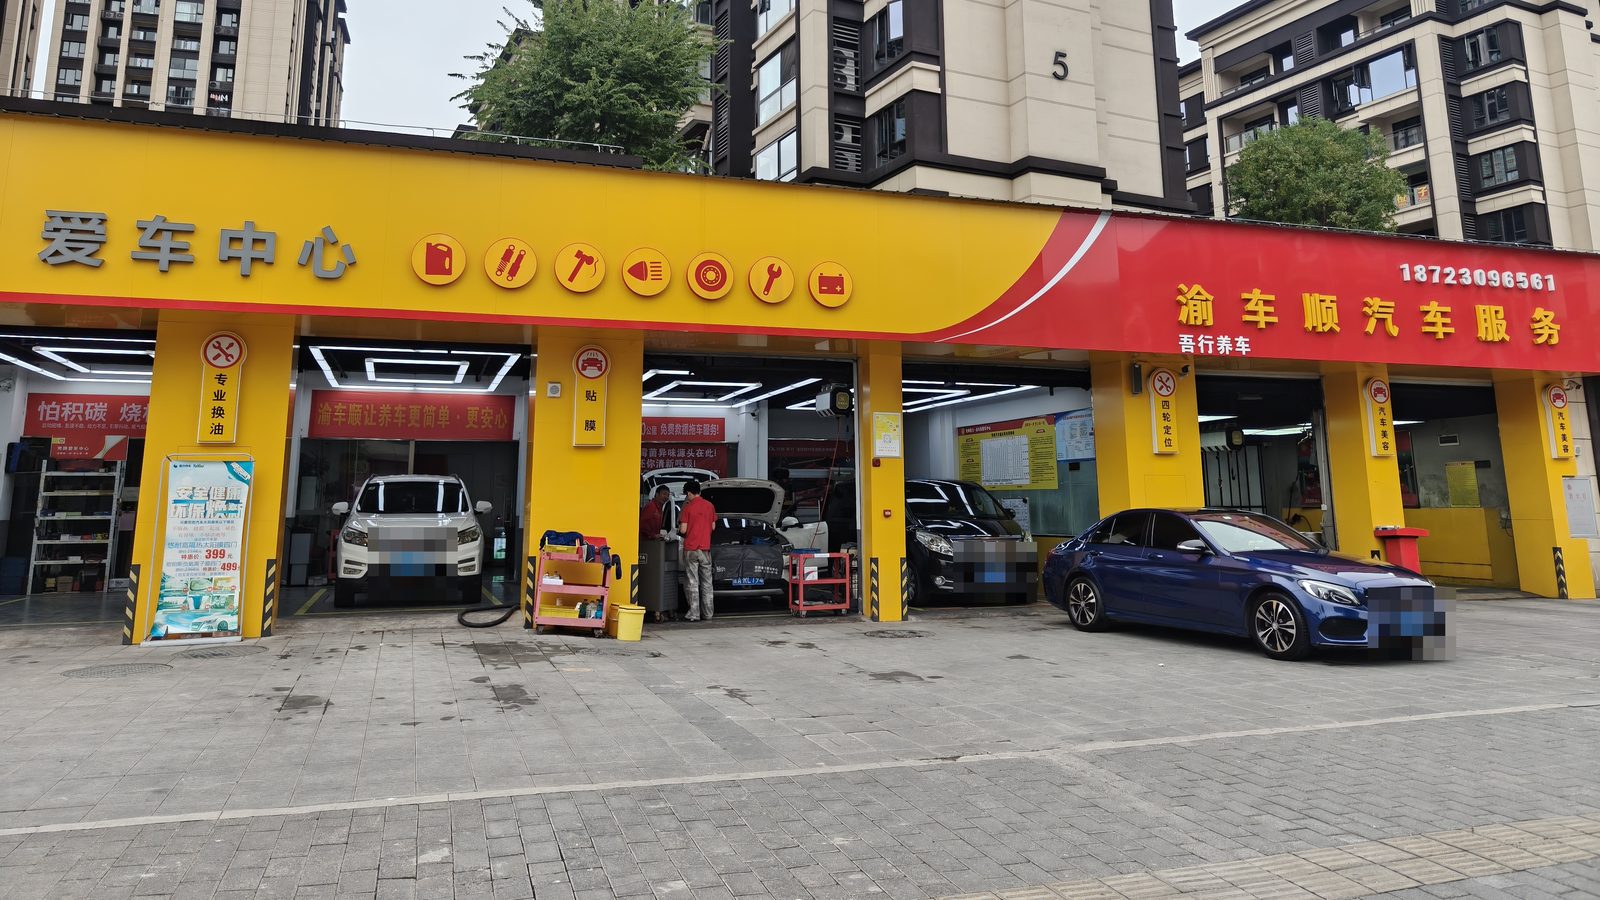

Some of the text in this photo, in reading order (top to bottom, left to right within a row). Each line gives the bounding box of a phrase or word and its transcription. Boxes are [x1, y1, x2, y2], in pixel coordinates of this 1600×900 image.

[1052, 51, 1069, 80] 5
[38, 209, 357, 280] 爱车中心
[1399, 263, 1556, 292] 18723096561
[1175, 282, 1562, 346] 渝车顺汽车服务
[1178, 334, 1251, 355] 吾行养车
[38, 401, 150, 422] 怕积碳 烧
[209, 373, 228, 435] 专业换油
[584, 390, 597, 431] 贴膜
[1161, 400, 1173, 447] 四轮定位
[1378, 406, 1390, 451] 汽车美容
[1557, 411, 1569, 454] 汽车美容
[205, 548, 226, 560] 399
[220, 562, 238, 572] 499
